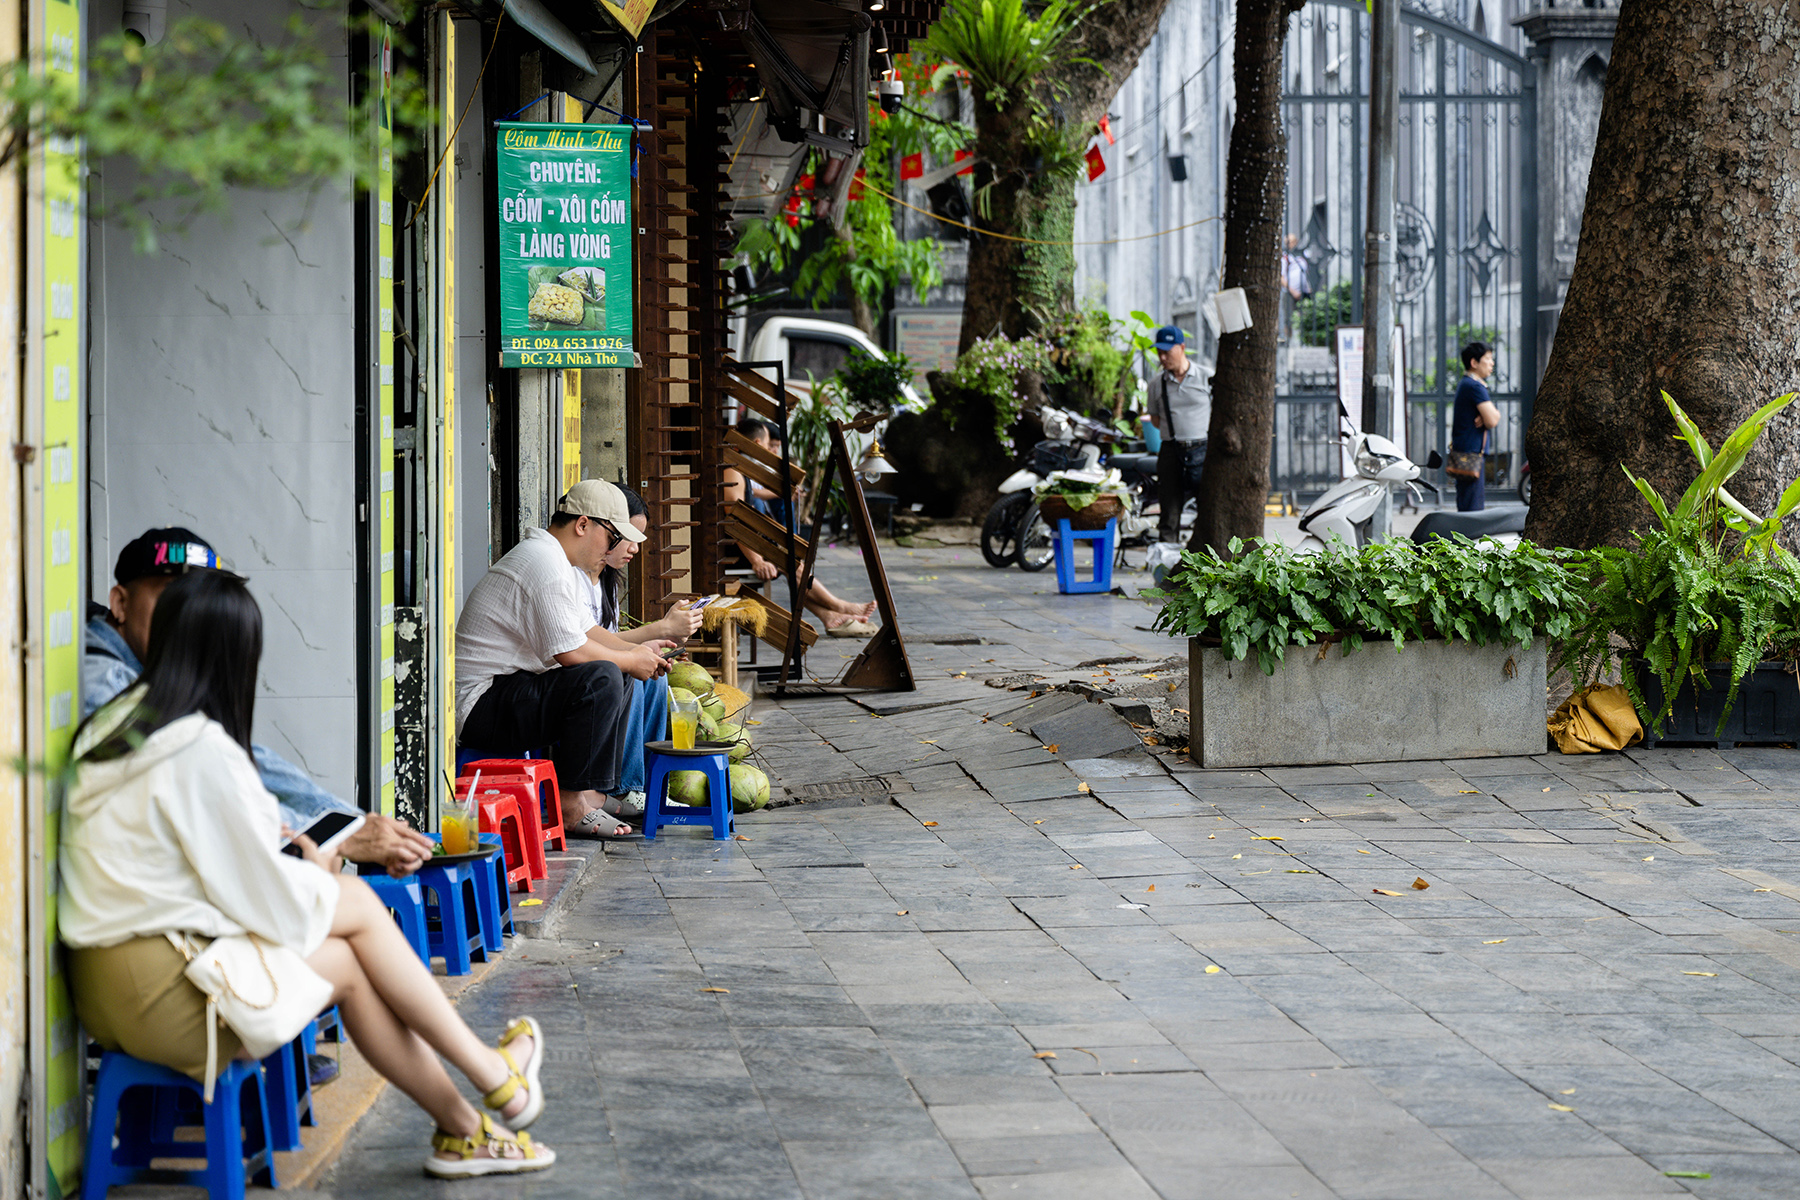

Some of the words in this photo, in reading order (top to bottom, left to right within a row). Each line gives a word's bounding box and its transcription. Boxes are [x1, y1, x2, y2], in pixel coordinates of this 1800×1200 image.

[505, 128, 539, 147] Cốm
[542, 129, 585, 148] Minh
[591, 130, 623, 149] Thu
[530, 158, 601, 183] CHUYÊN:
[503, 189, 542, 223] CỐM
[559, 194, 586, 223] XÔI
[591, 191, 626, 224] CỐM
[520, 228, 565, 258] LÀNG
[570, 228, 611, 259] VÒNG
[512, 338, 530, 349] ĐT:
[534, 338, 559, 349] 094
[563, 338, 587, 349] 653
[592, 338, 623, 349] 1976
[520, 352, 542, 365] ĐC:
[546, 352, 562, 365] 24
[567, 352, 592, 365] Nhà
[594, 352, 618, 365] Thờ
